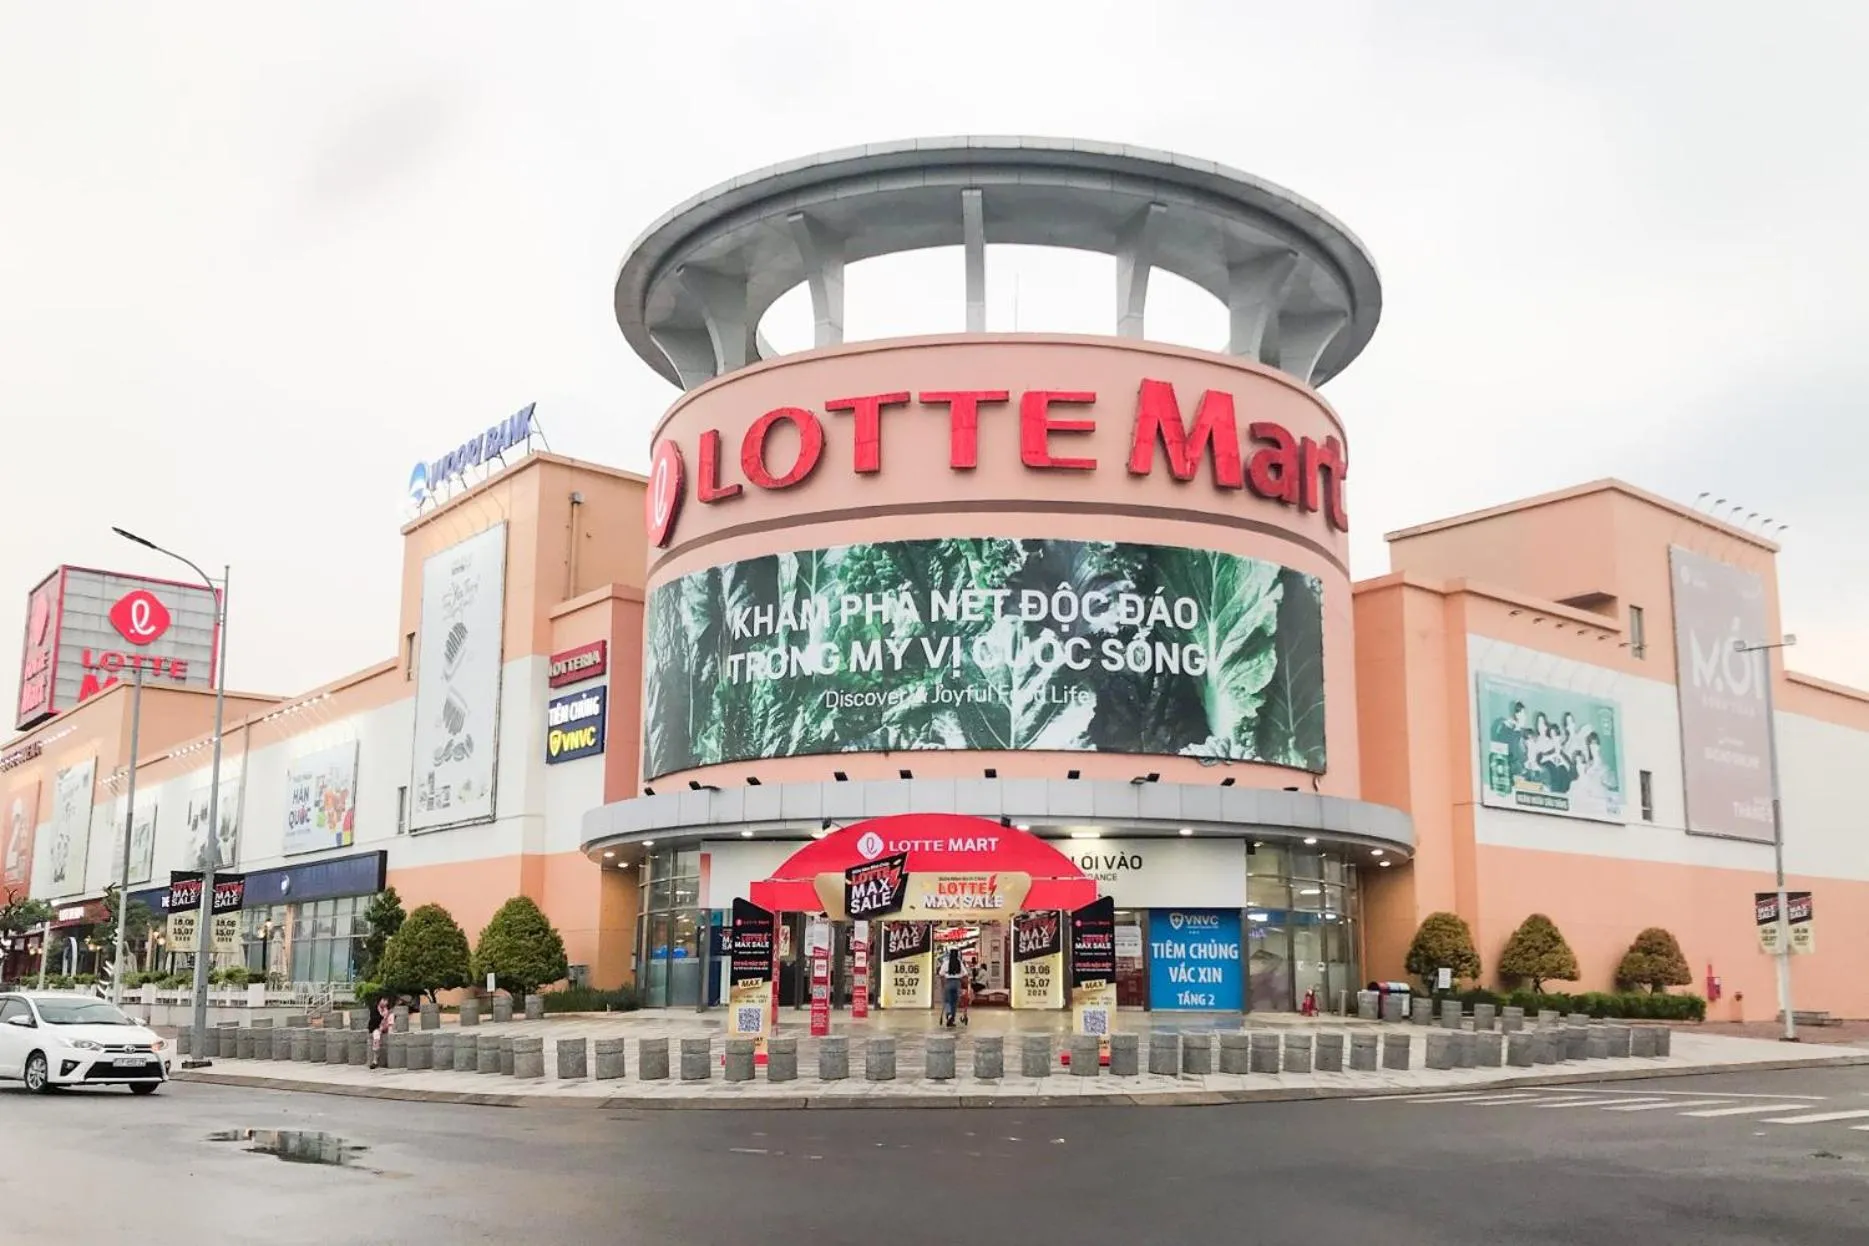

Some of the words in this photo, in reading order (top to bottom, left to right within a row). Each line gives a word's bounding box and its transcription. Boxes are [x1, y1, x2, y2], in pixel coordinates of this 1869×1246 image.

[698, 389, 1097, 504] LOTTE
[1127, 378, 1349, 533] Mart
[841, 581, 921, 626] PHÁ
[1019, 582, 1110, 632] ĐỘC
[1118, 586, 1198, 630] ĐÁO
[82, 646, 188, 681] LOTTE
[728, 641, 840, 685] TRONG
[920, 635, 961, 677] VỊ
[1100, 631, 1207, 676] SỐNG
[825, 689, 908, 708] Discover
[931, 684, 992, 708] Joyful
[1051, 684, 1089, 704] Life
[562, 726, 596, 752] VNVC
[888, 839, 945, 852] LOTTE
[948, 837, 999, 852] MART
[1103, 851, 1142, 870] VÀO
[173, 888, 196, 898] MAX
[215, 889, 238, 900] MAX
[852, 878, 890, 900] MAX
[937, 882, 987, 895] LOTTE
[171, 896, 197, 907] SALE
[214, 897, 239, 908] SALE
[850, 891, 891, 913] SALE
[925, 895, 960, 909] MAX
[962, 895, 1004, 909] SALE
[1185, 915, 1219, 925] VNVC
[889, 925, 919, 942] MAX
[1019, 926, 1049, 943] MAX
[734, 941, 751, 949] MAX
[751, 941, 769, 949] SALE
[888, 936, 920, 953] SALE
[1019, 937, 1050, 954] SALE
[1075, 942, 1092, 950] MAX
[1093, 942, 1112, 950] SALE
[1151, 940, 1186, 959] TIÊM
[1190, 938, 1239, 960] CHỦNG
[740, 978, 759, 988] MAX
[893, 977, 920, 987] 15.07
[1024, 978, 1050, 988] 15.07
[1198, 967, 1223, 984] XIN
[1085, 981, 1104, 990] MAX
[1208, 994, 1216, 1006] 2
